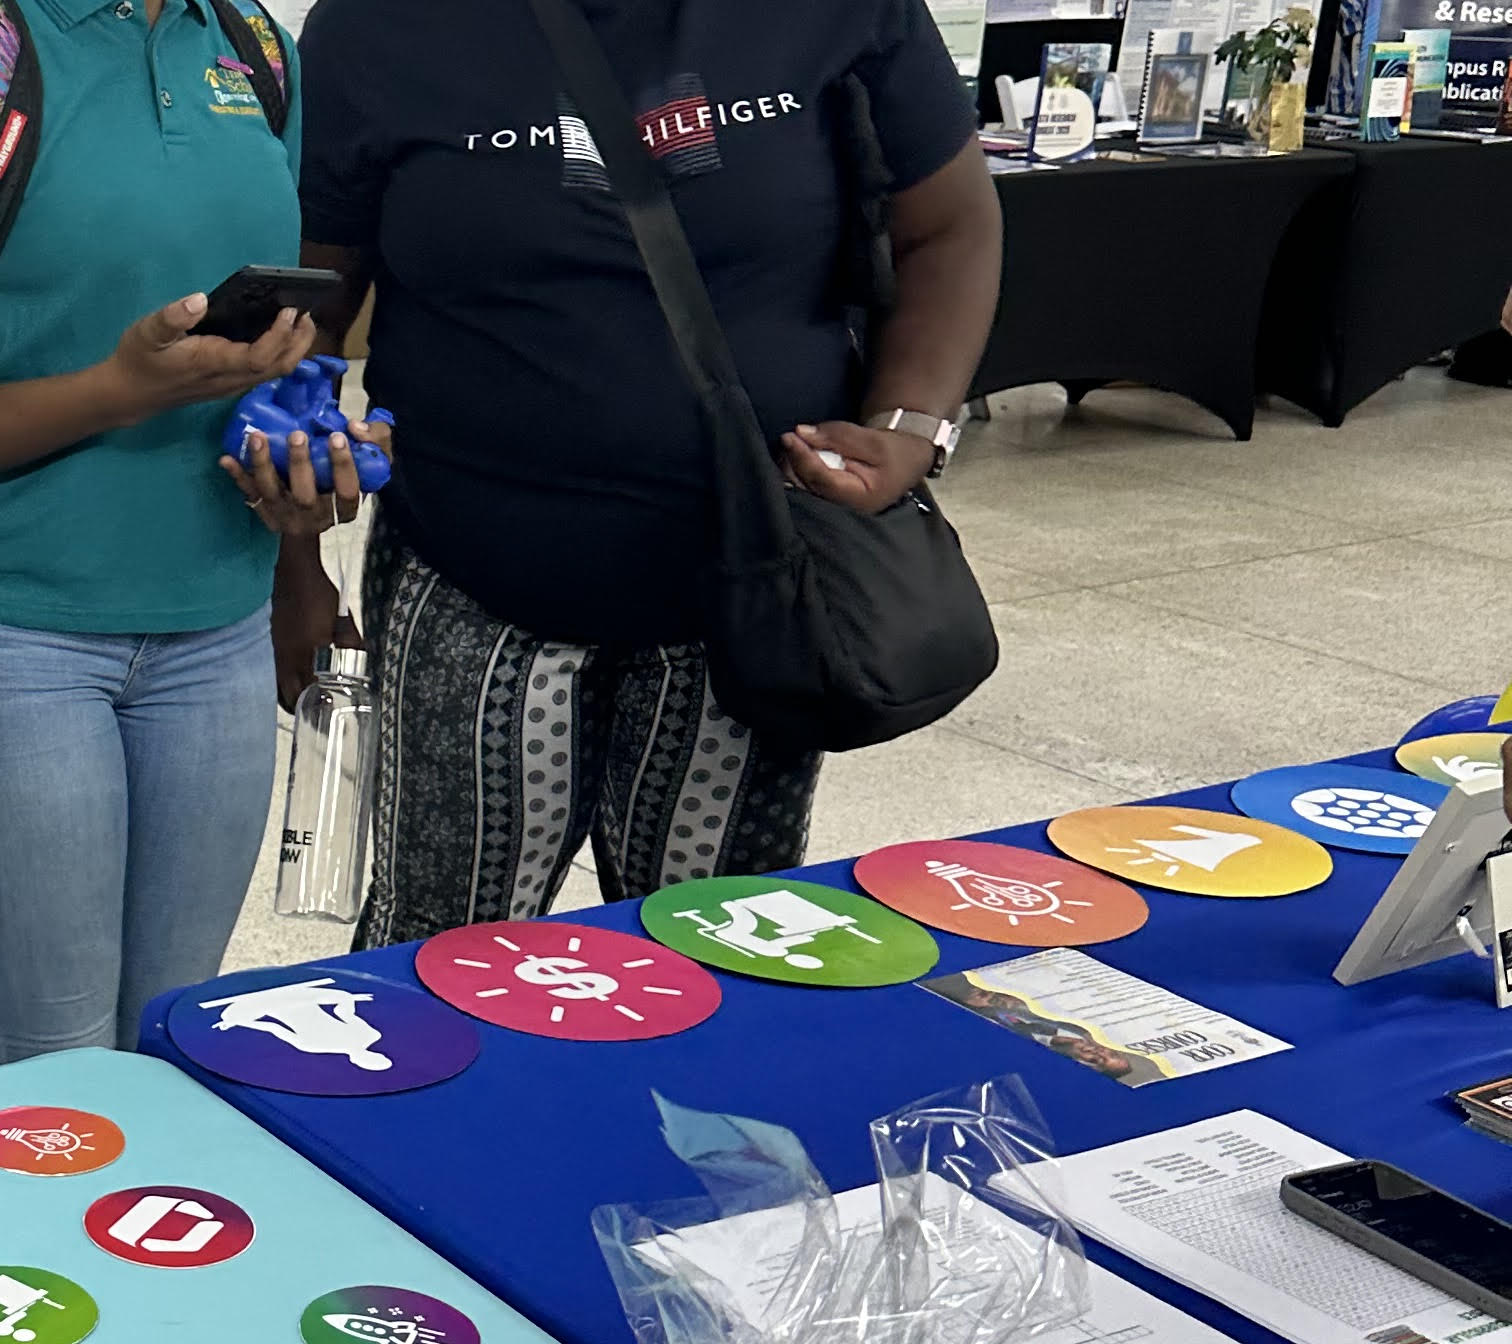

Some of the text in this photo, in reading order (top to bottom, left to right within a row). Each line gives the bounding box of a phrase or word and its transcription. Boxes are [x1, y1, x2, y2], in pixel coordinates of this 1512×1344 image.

[1434, 1, 1512, 23] & Rese
[464, 125, 586, 151] TOM
[1125, 1030, 1208, 1055] COURSES
